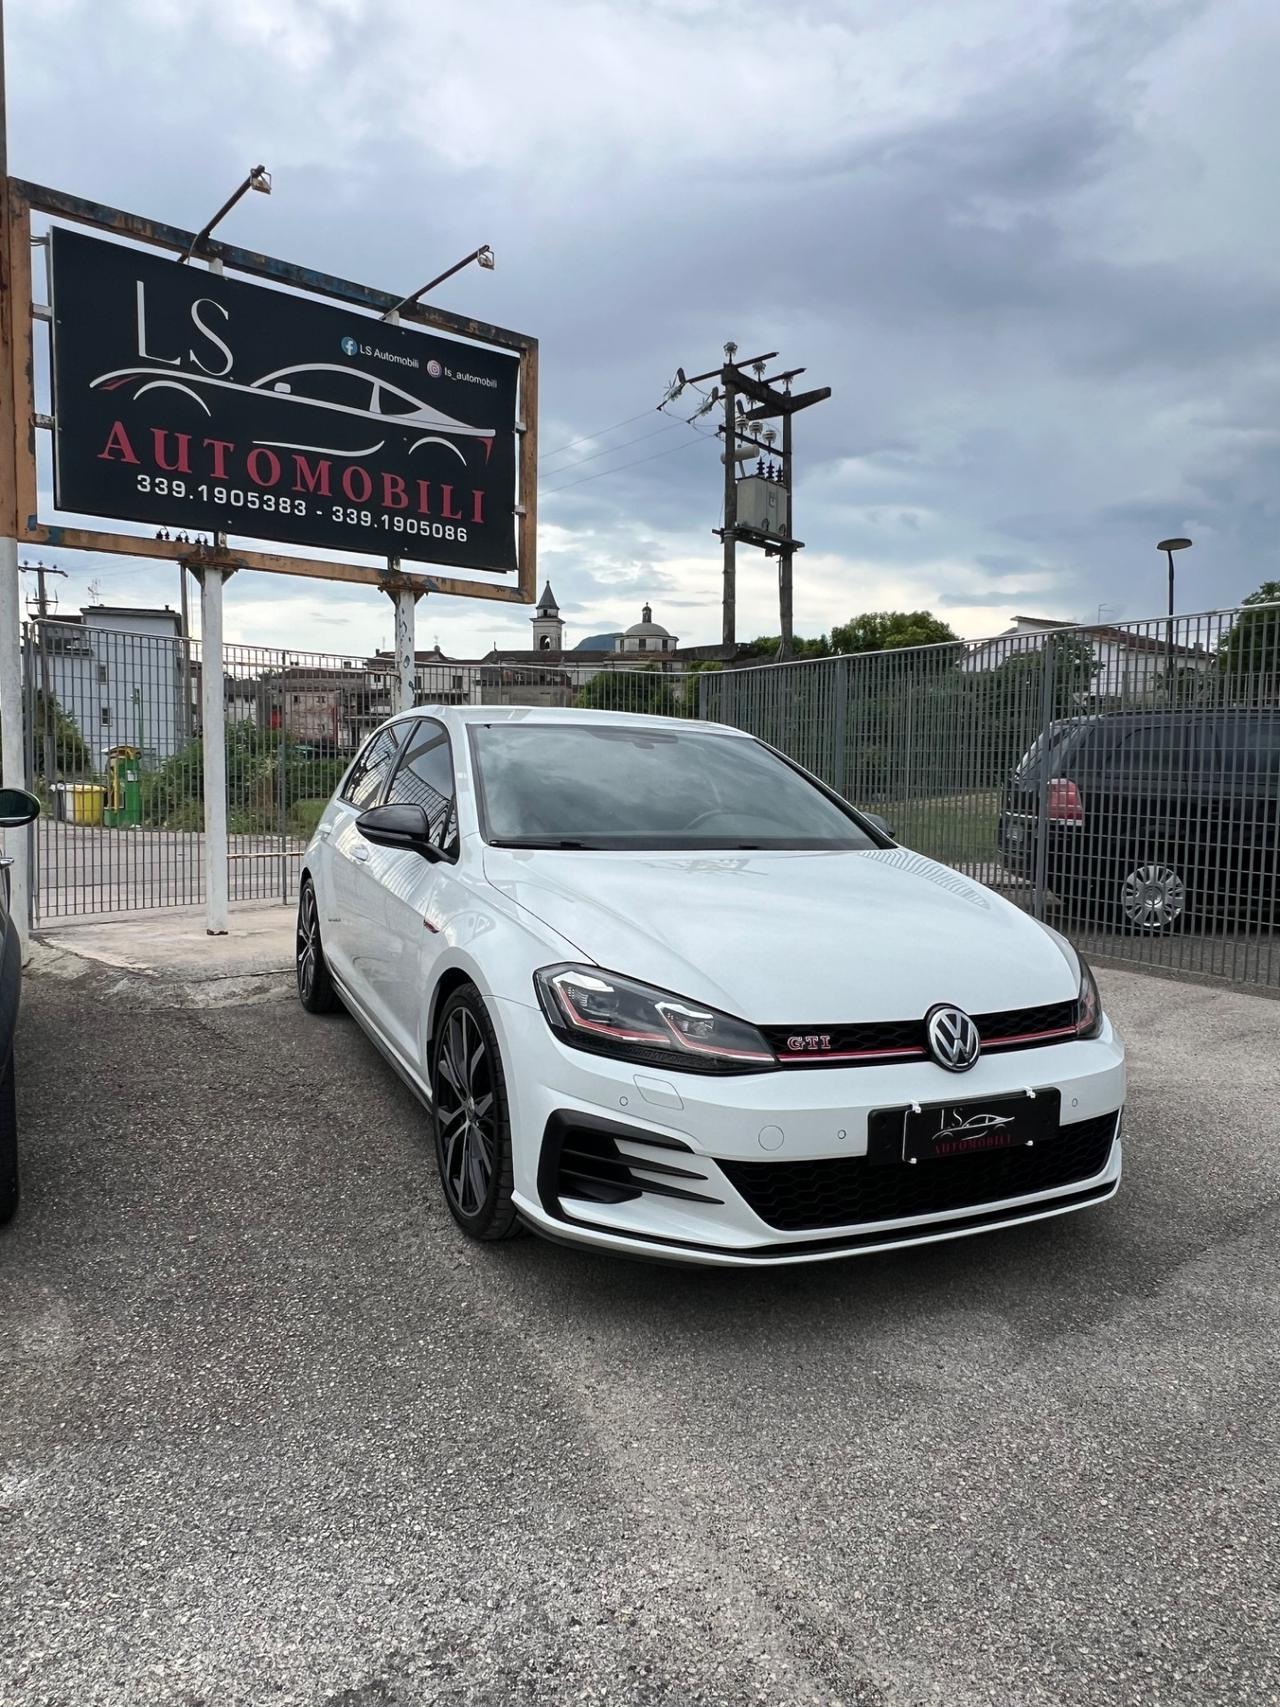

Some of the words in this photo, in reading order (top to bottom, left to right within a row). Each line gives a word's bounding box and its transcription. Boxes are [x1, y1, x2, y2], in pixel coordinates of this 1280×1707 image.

[359, 344, 372, 356] LS
[374, 349, 419, 369] Automobili
[97, 420, 486, 523] AUTOMOBILI
[136, 474, 307, 516] 339.1905383
[331, 505, 468, 543] 339.1905086
[787, 1035, 831, 1050] GTI
